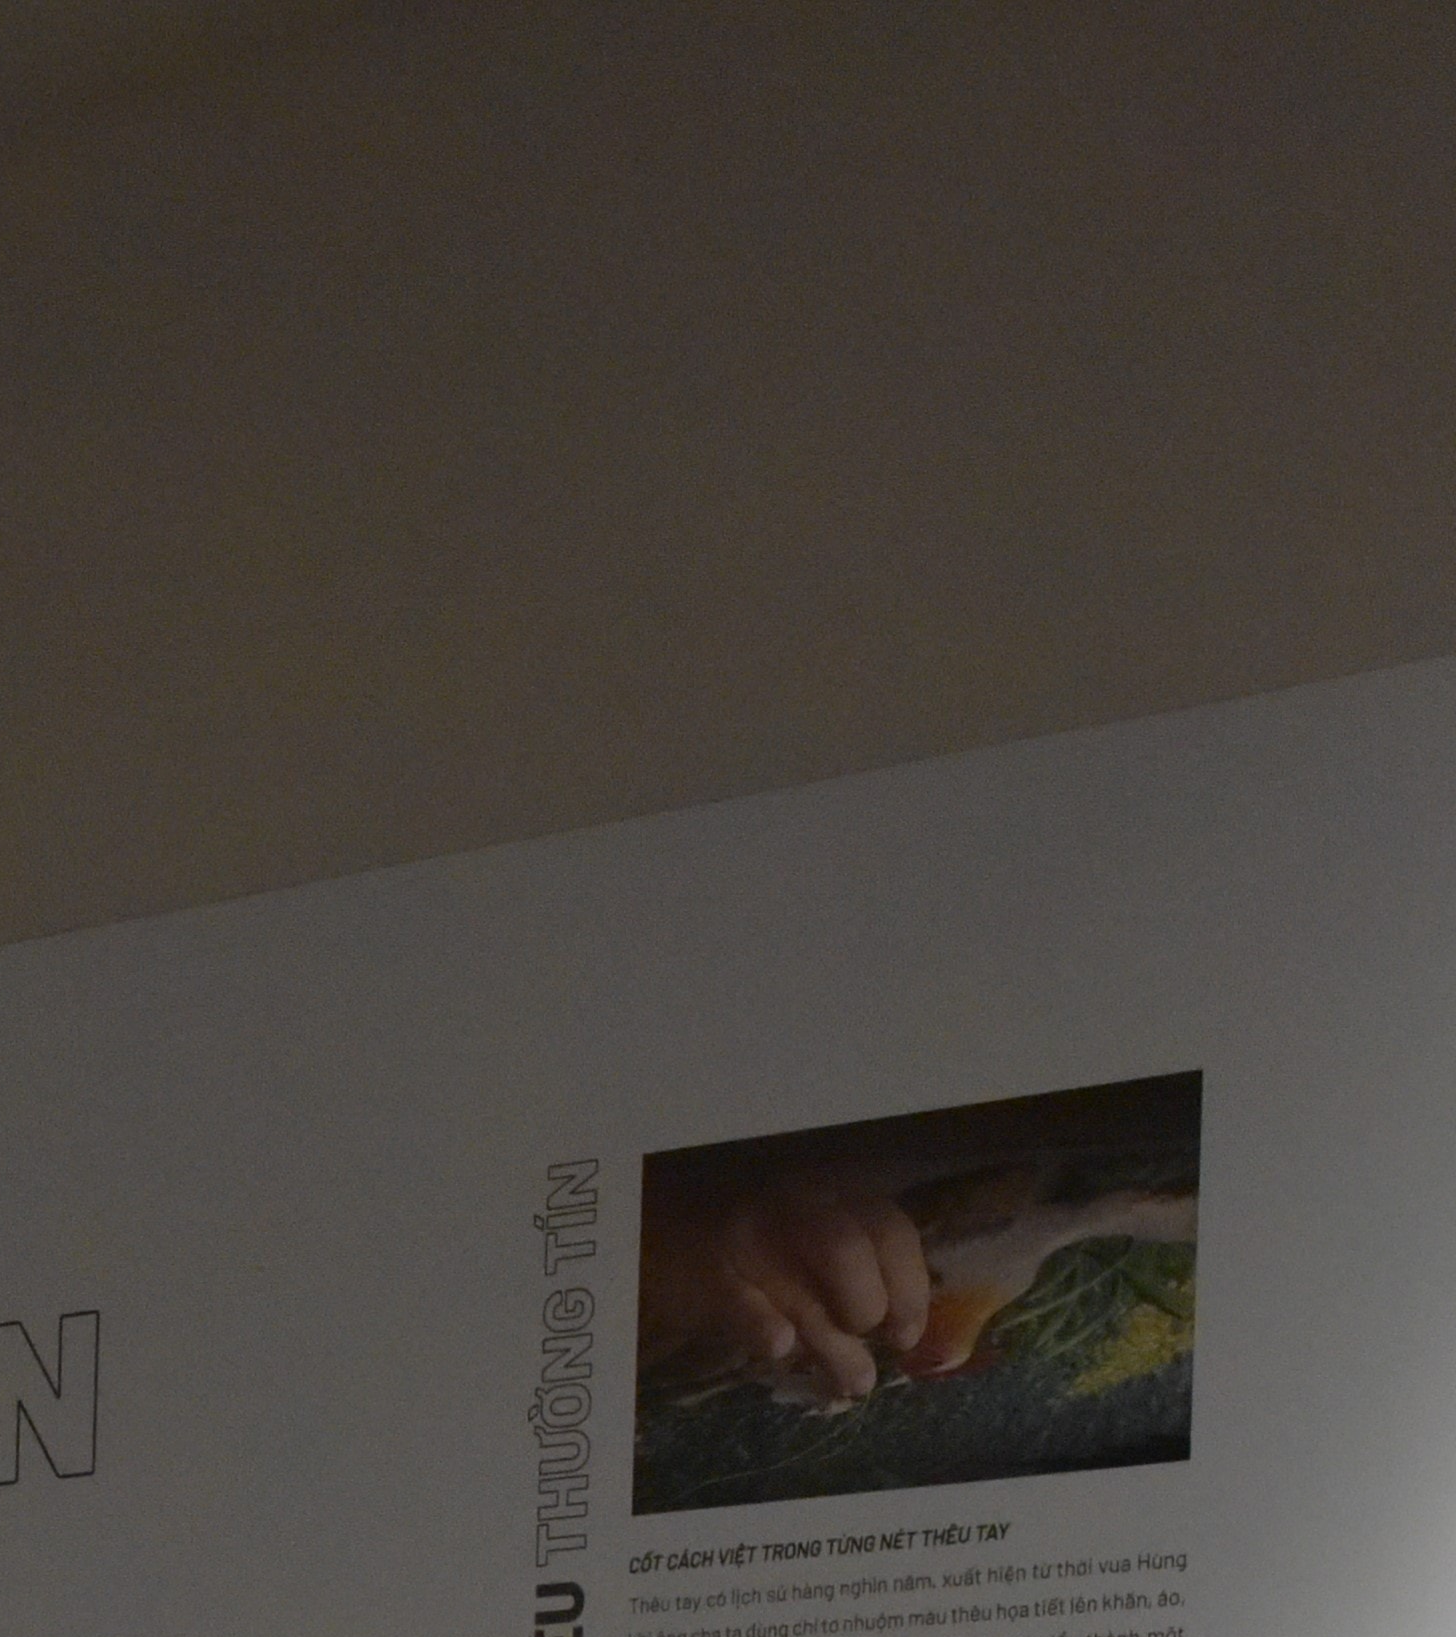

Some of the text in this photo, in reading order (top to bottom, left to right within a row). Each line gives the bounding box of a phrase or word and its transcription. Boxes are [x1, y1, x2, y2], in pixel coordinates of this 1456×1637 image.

[533, 1158, 600, 1277] TÍN
[528, 1286, 596, 1568] THƯỜNG
[666, 1548, 715, 1572] CÁCH
[719, 1542, 758, 1569] VIỆT
[762, 1538, 822, 1564] TRONG
[921, 1523, 973, 1548] THÊU
[977, 1522, 1011, 1543] TAY
